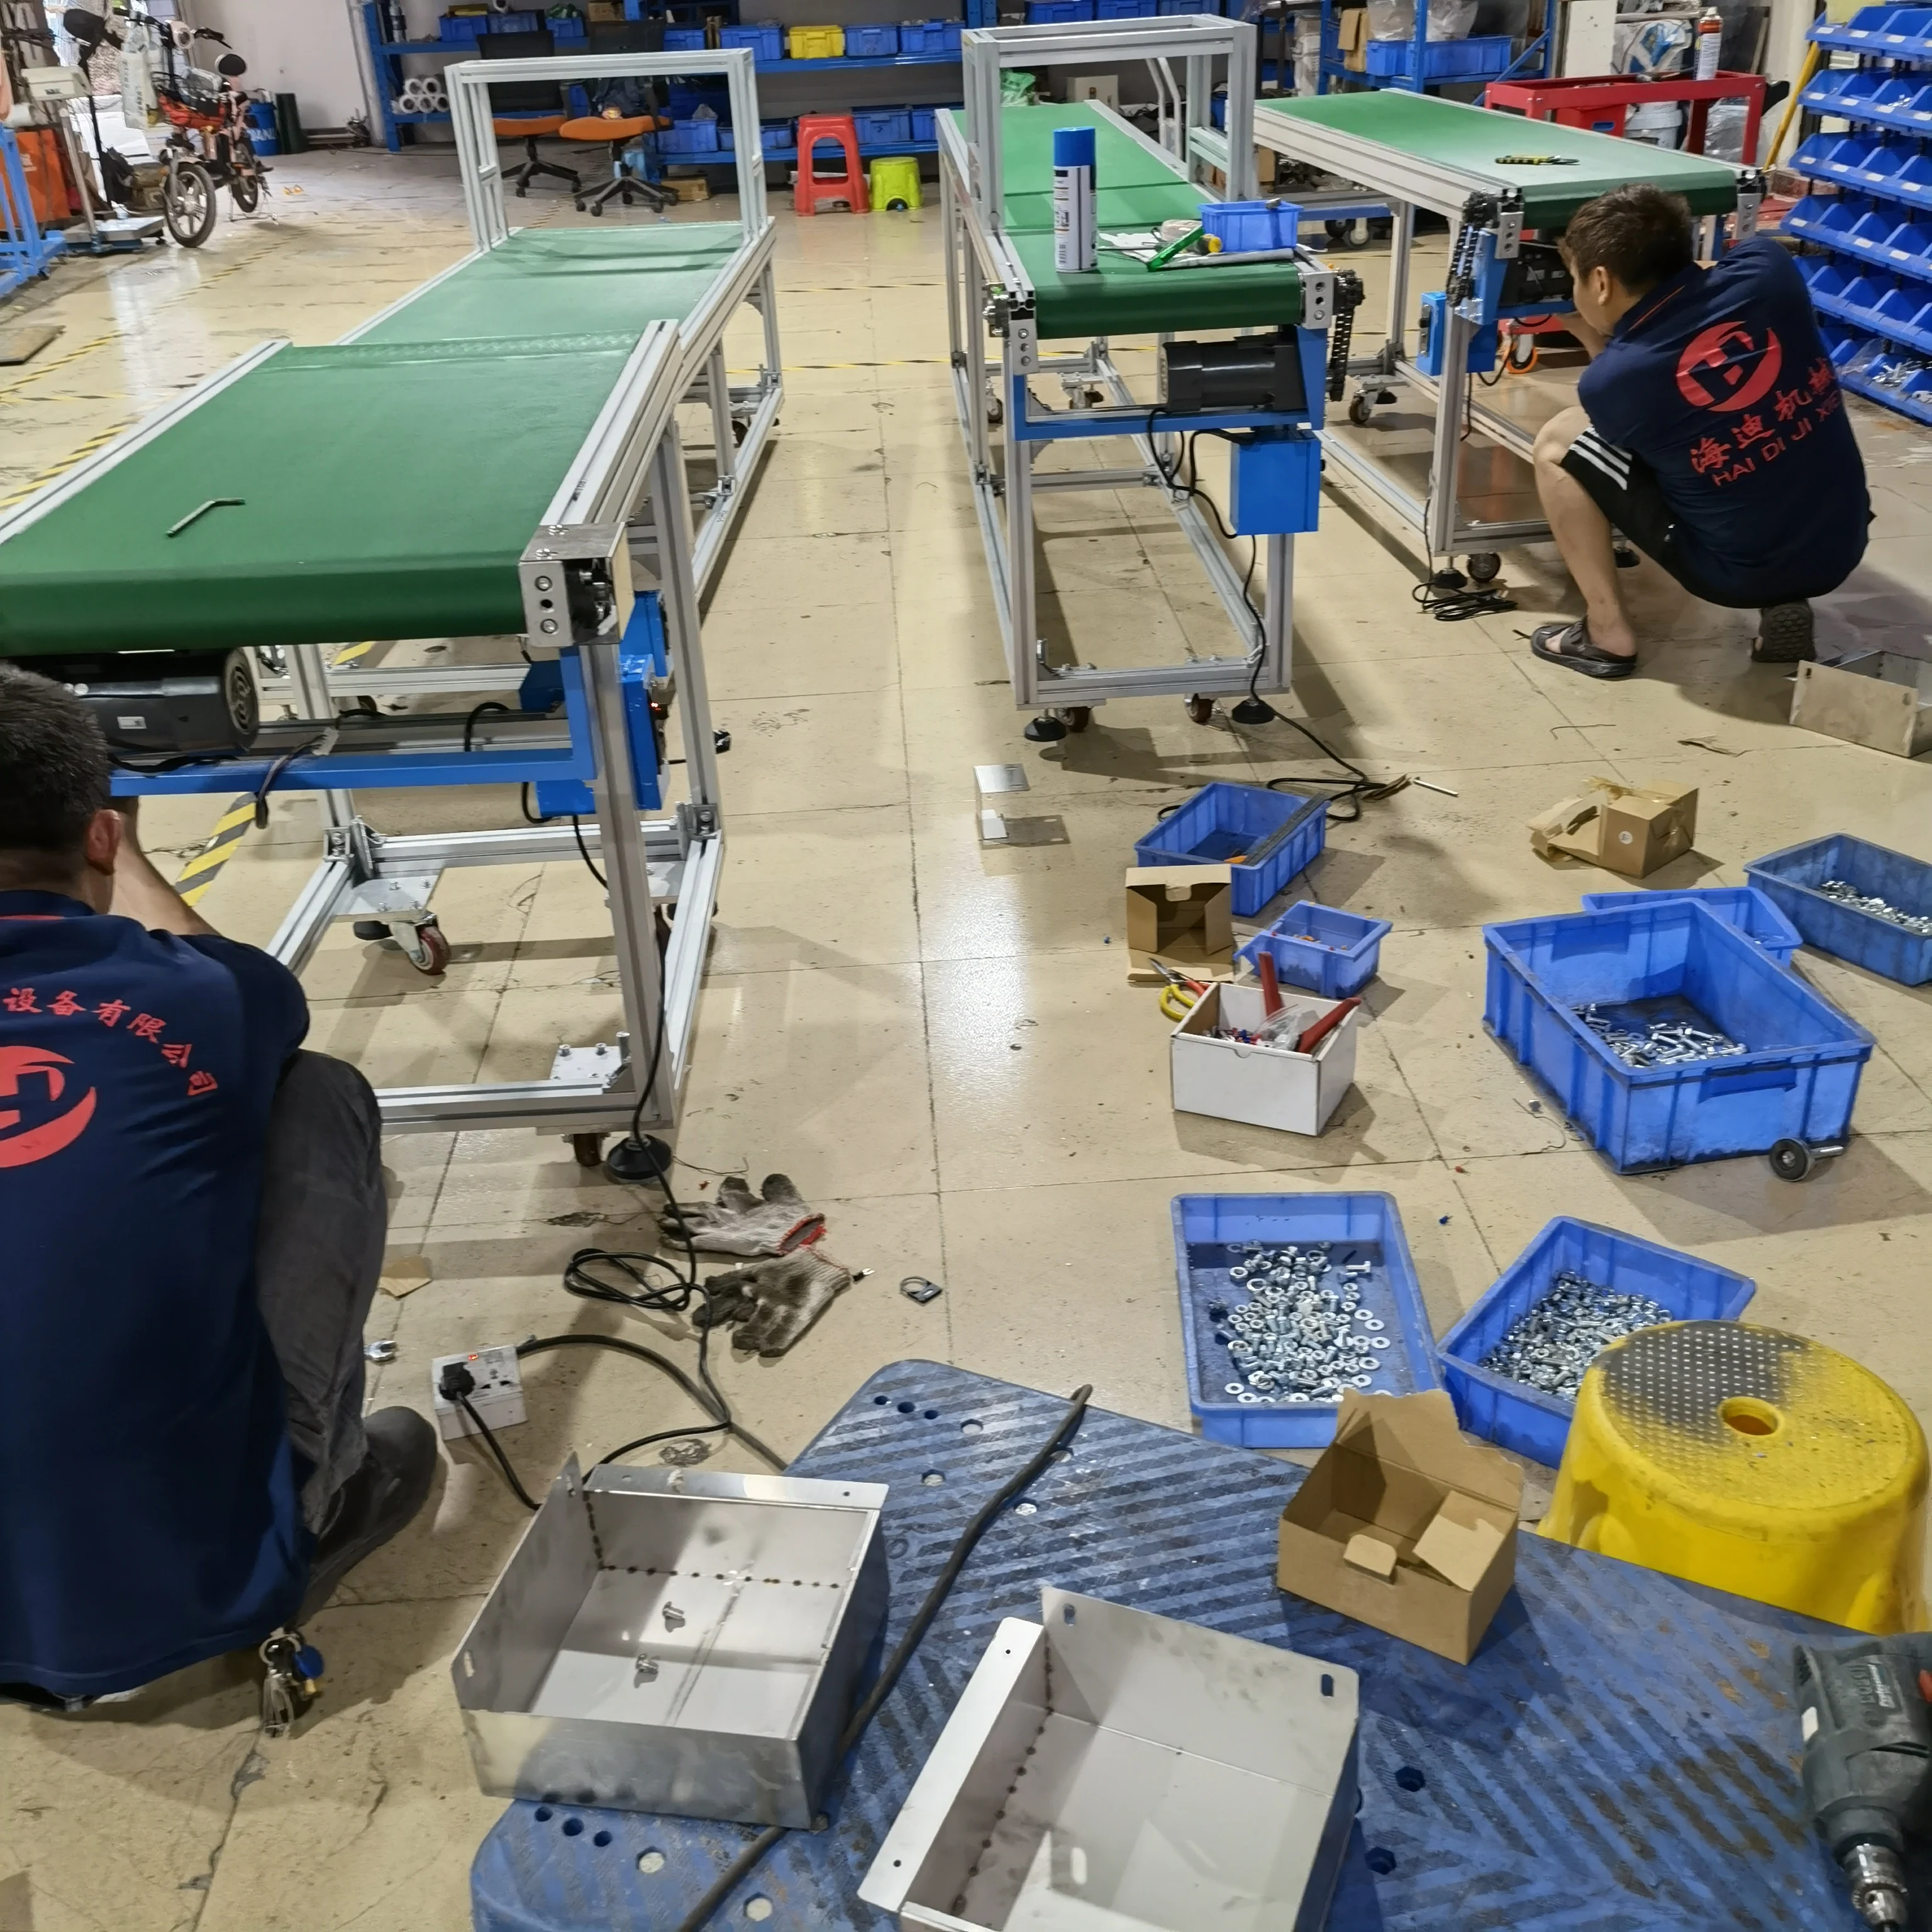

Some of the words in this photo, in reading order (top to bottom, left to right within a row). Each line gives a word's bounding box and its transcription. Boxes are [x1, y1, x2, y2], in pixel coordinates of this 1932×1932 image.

[1711, 457, 1756, 487] HAI
[1761, 436, 1787, 462] DI
[1790, 417, 1813, 441] JI
